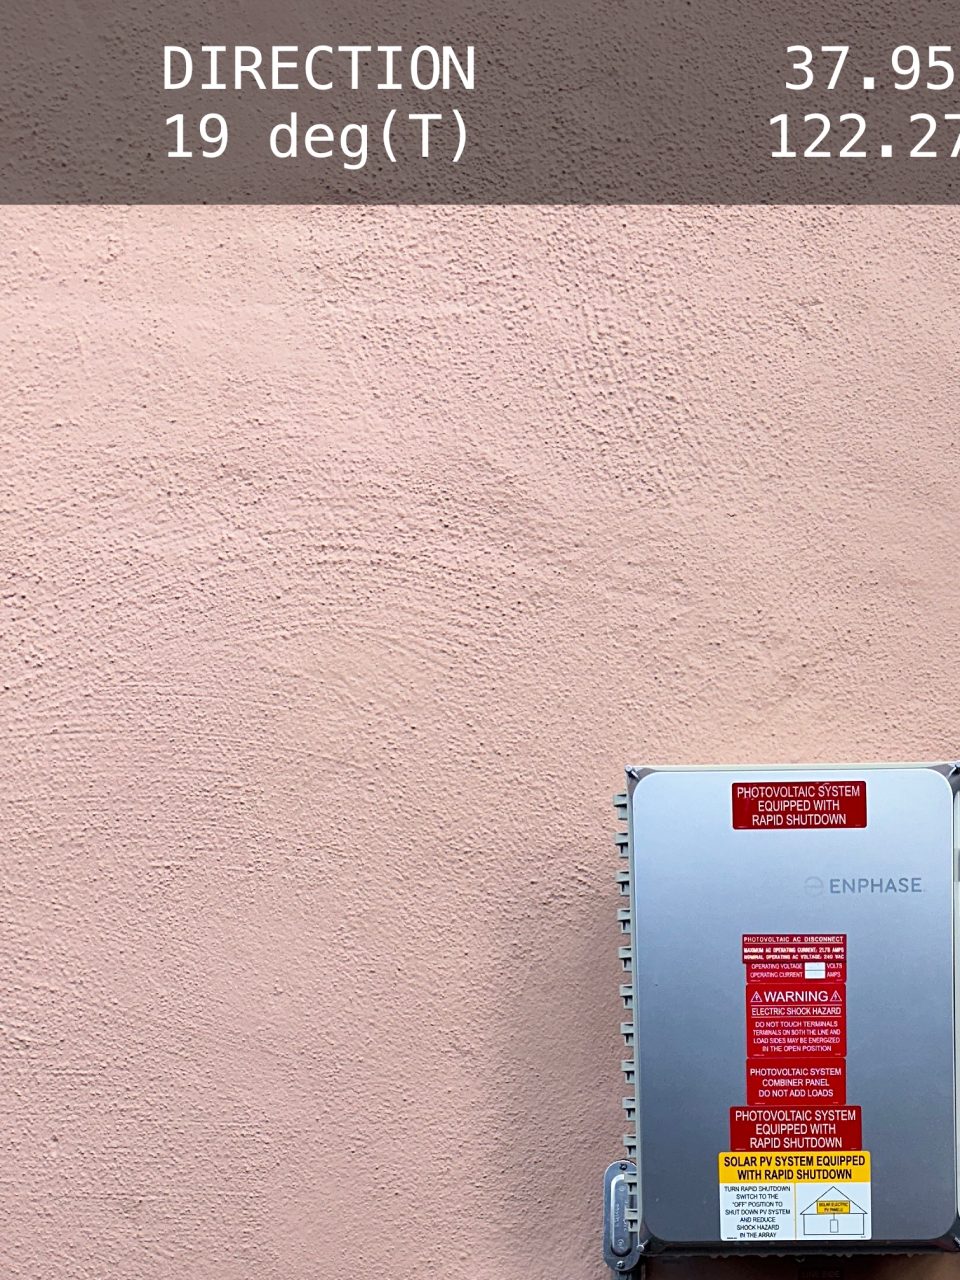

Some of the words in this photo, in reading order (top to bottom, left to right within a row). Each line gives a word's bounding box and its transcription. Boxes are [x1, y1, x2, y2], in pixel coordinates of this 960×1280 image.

[738, 786, 815, 799] PHOTOVOLTAIC
[818, 785, 860, 797] SYSTEM
[758, 800, 810, 812] EQUIPPED
[813, 800, 840, 811] WITH
[752, 815, 783, 826] RAPID
[786, 814, 846, 825] SHUTDOWN
[830, 878, 922, 894] ENPHASE
[764, 991, 828, 1002] WARNING
[813, 1007, 841, 1015] HAZARD
[750, 1068, 808, 1076] PHOTOVOLTAIC
[762, 1079, 803, 1087] COMBINER
[808, 1089, 833, 1097] LOADS
[736, 1111, 812, 1121] PHOTOVOLTAIC
[815, 1110, 856, 1120] SYSTEM
[756, 1124, 807, 1135] EQUIPPED
[810, 1124, 836, 1134] WITH
[750, 1138, 780, 1148] RAPID
[783, 1137, 842, 1148] SHUTDOWN
[724, 1156, 756, 1167] SOLAR
[760, 1156, 772, 1166] PV
[776, 1156, 814, 1166] SYSTEM
[817, 1155, 865, 1166] EQUIPPED
[738, 1170, 761, 1180] WITH
[765, 1170, 793, 1180] RAPID
[797, 1169, 852, 1179] SHUTDOWN
